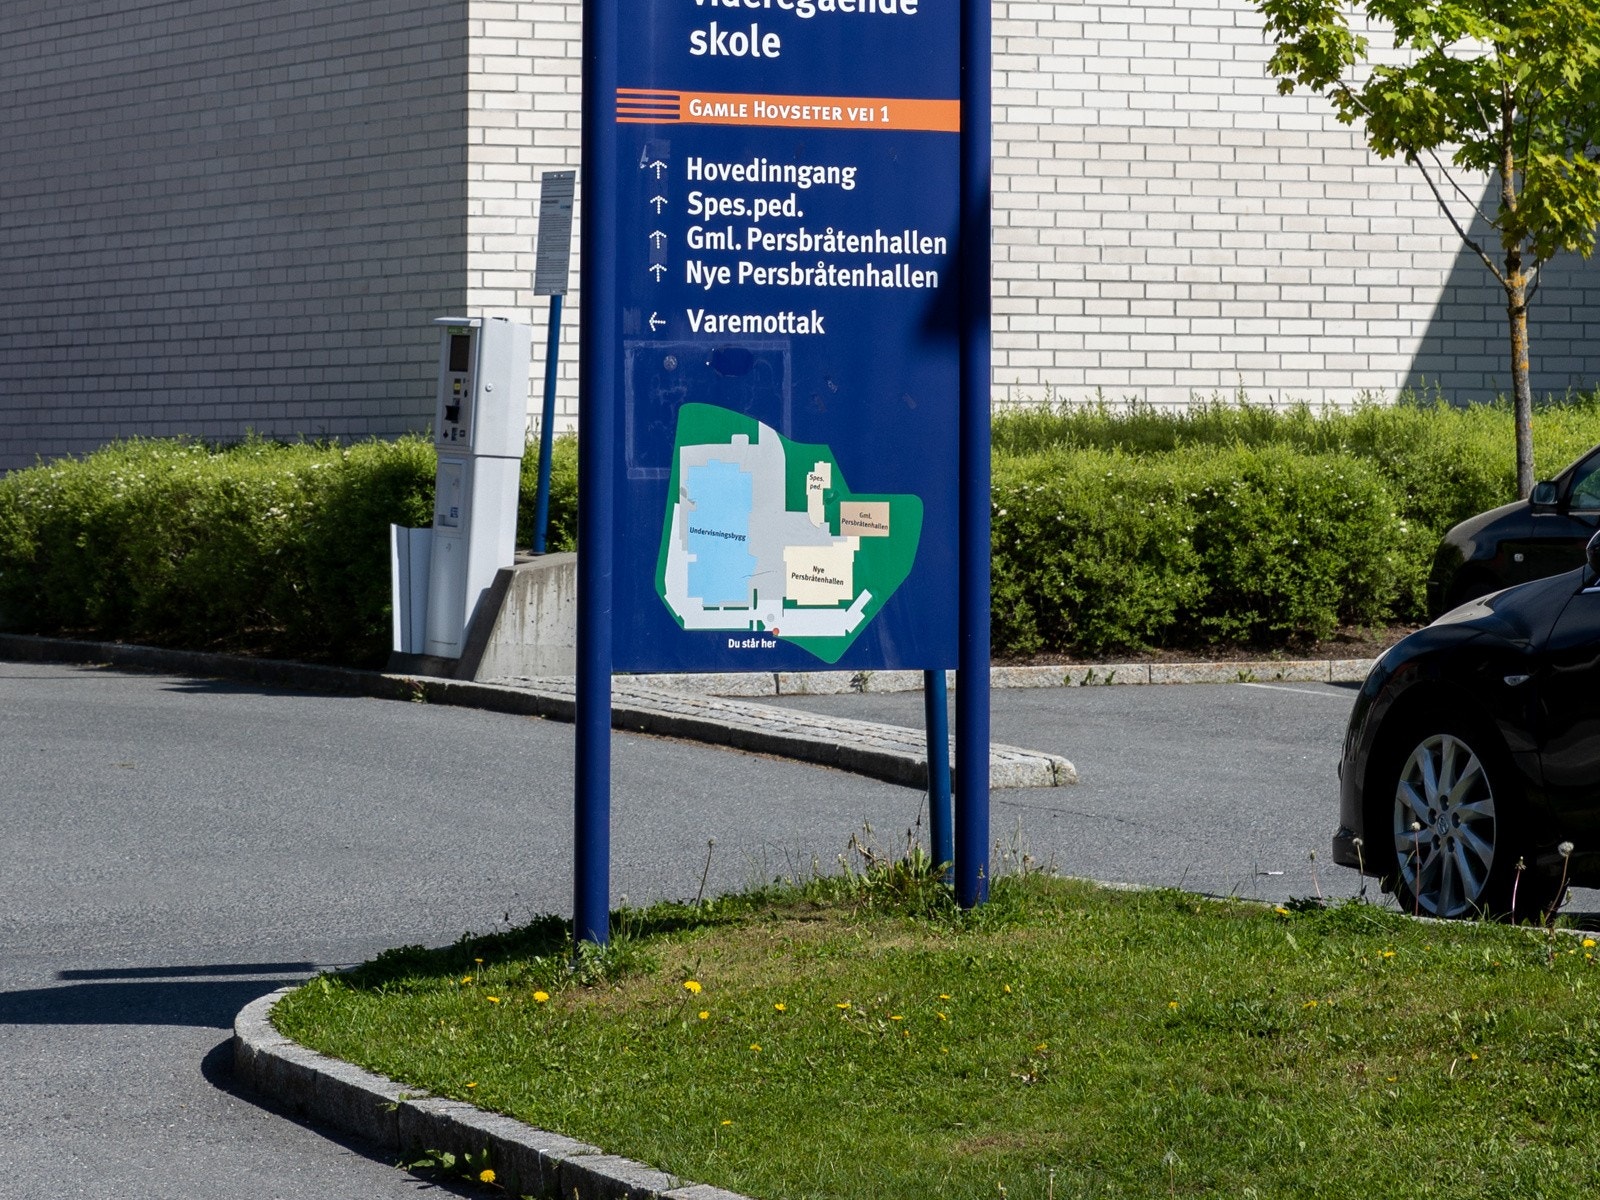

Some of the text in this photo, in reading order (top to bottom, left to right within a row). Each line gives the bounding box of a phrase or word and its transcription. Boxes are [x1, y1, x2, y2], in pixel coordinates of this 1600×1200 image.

[689, 21, 781, 58] skole
[880, 105, 890, 122] 1
[686, 156, 858, 190] Hovedinngang
[686, 226, 947, 255] Gml. Persbråtenhallen
[686, 260, 939, 291] Nye Persbråtenhallen
[686, 308, 826, 335] Varemottak
[809, 473, 825, 482] Spes.
[809, 483, 822, 491] ped.
[859, 511, 873, 520] Gml.
[841, 517, 889, 531] Persbråtenhallen
[689, 526, 747, 542] Undervisningsbygg
[812, 565, 825, 574] Nye
[791, 572, 845, 587] Persbråtenhallen
[728, 637, 777, 649] Du står her
